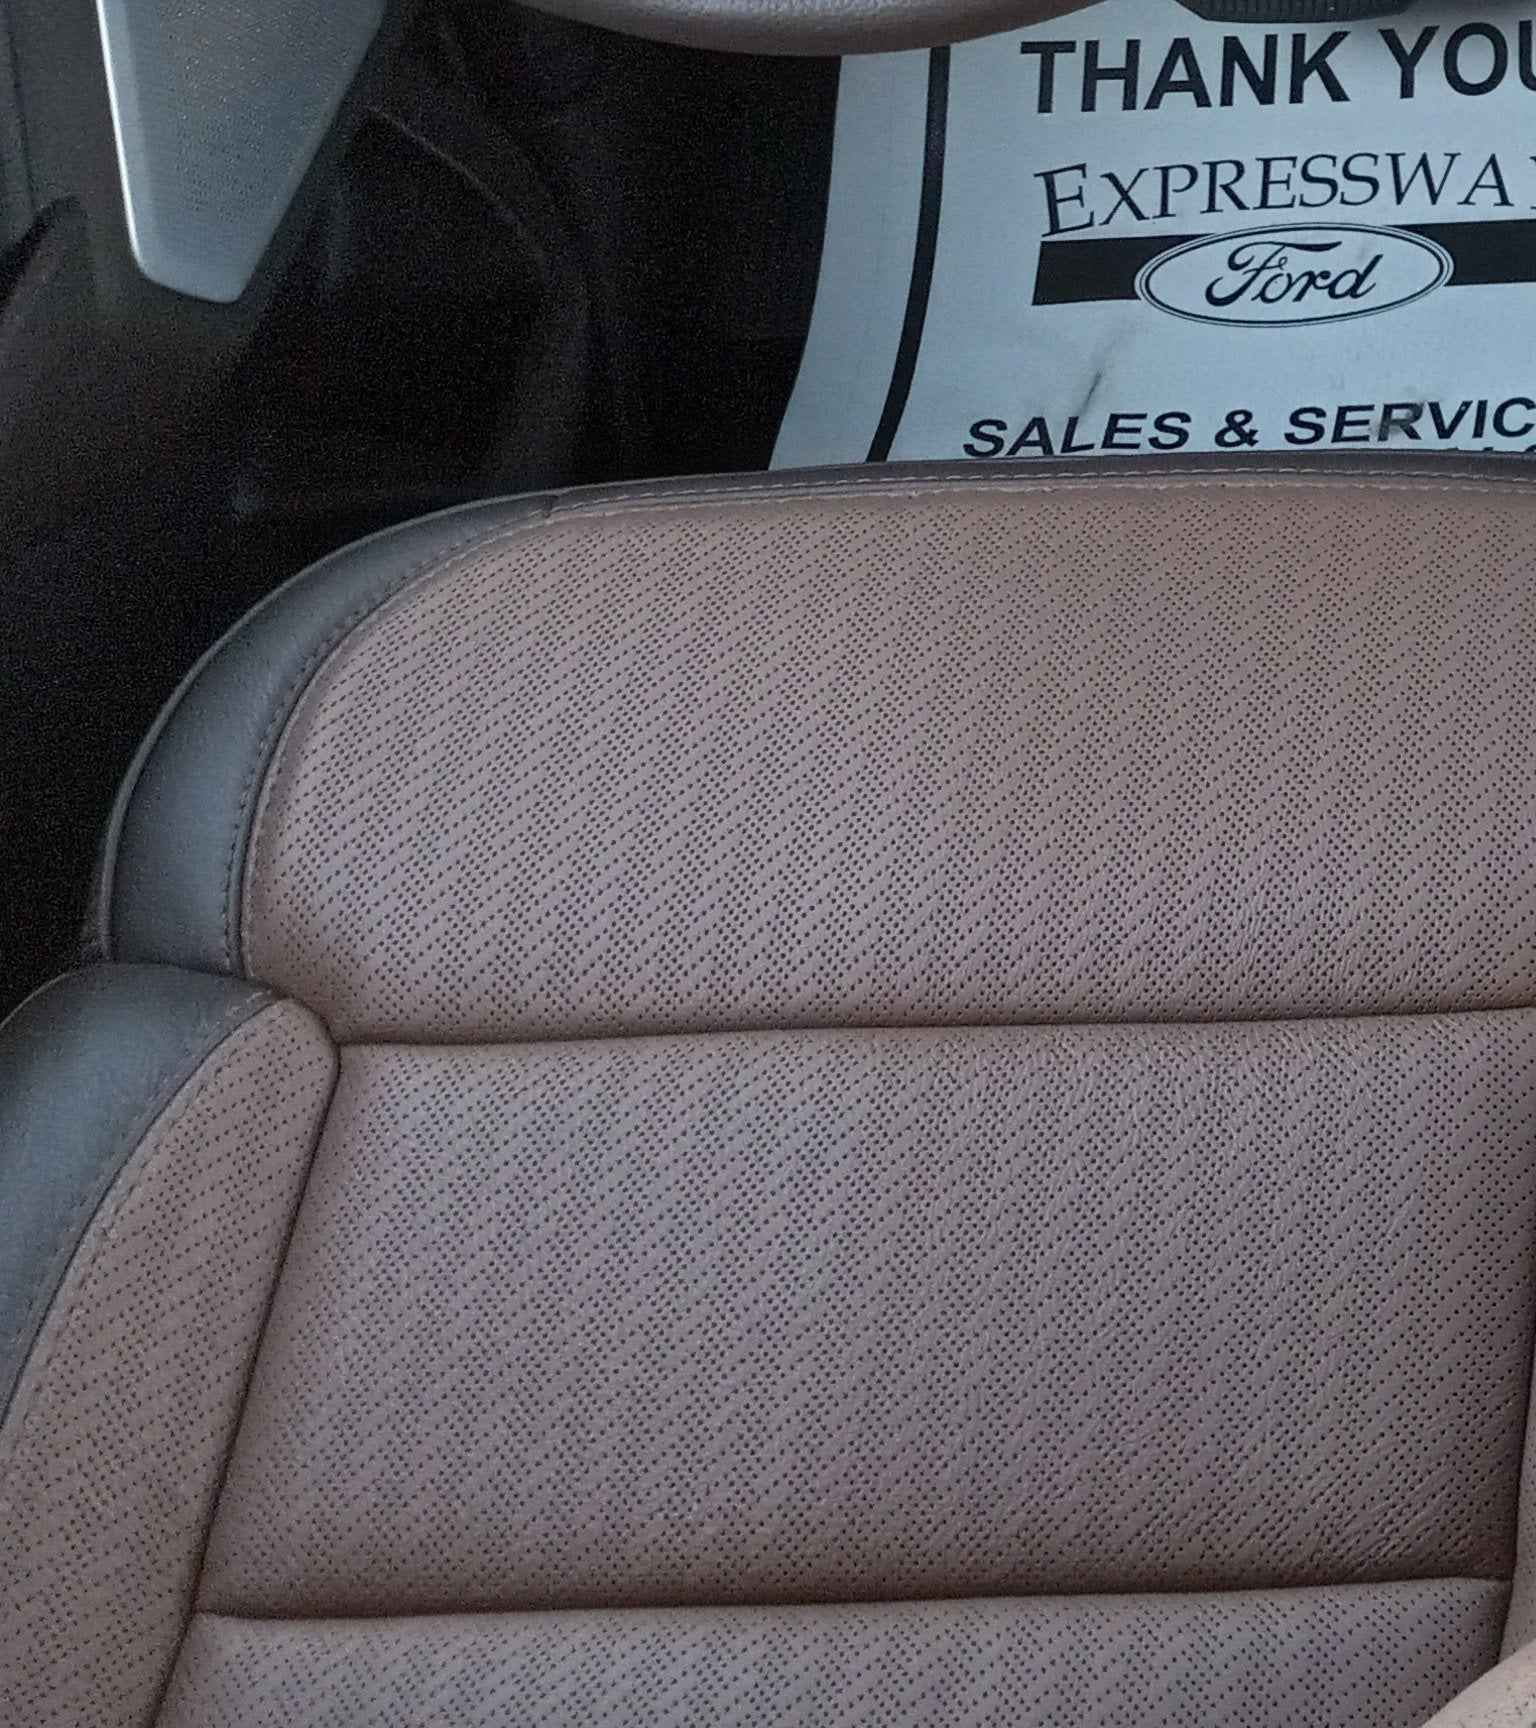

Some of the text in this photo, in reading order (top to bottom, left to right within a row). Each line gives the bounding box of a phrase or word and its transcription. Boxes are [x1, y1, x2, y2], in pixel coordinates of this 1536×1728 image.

[1020, 29, 1351, 116] THANK
[1203, 239, 1378, 309] Ford
[962, 409, 1192, 457] SALES
[1213, 408, 1262, 449] &
